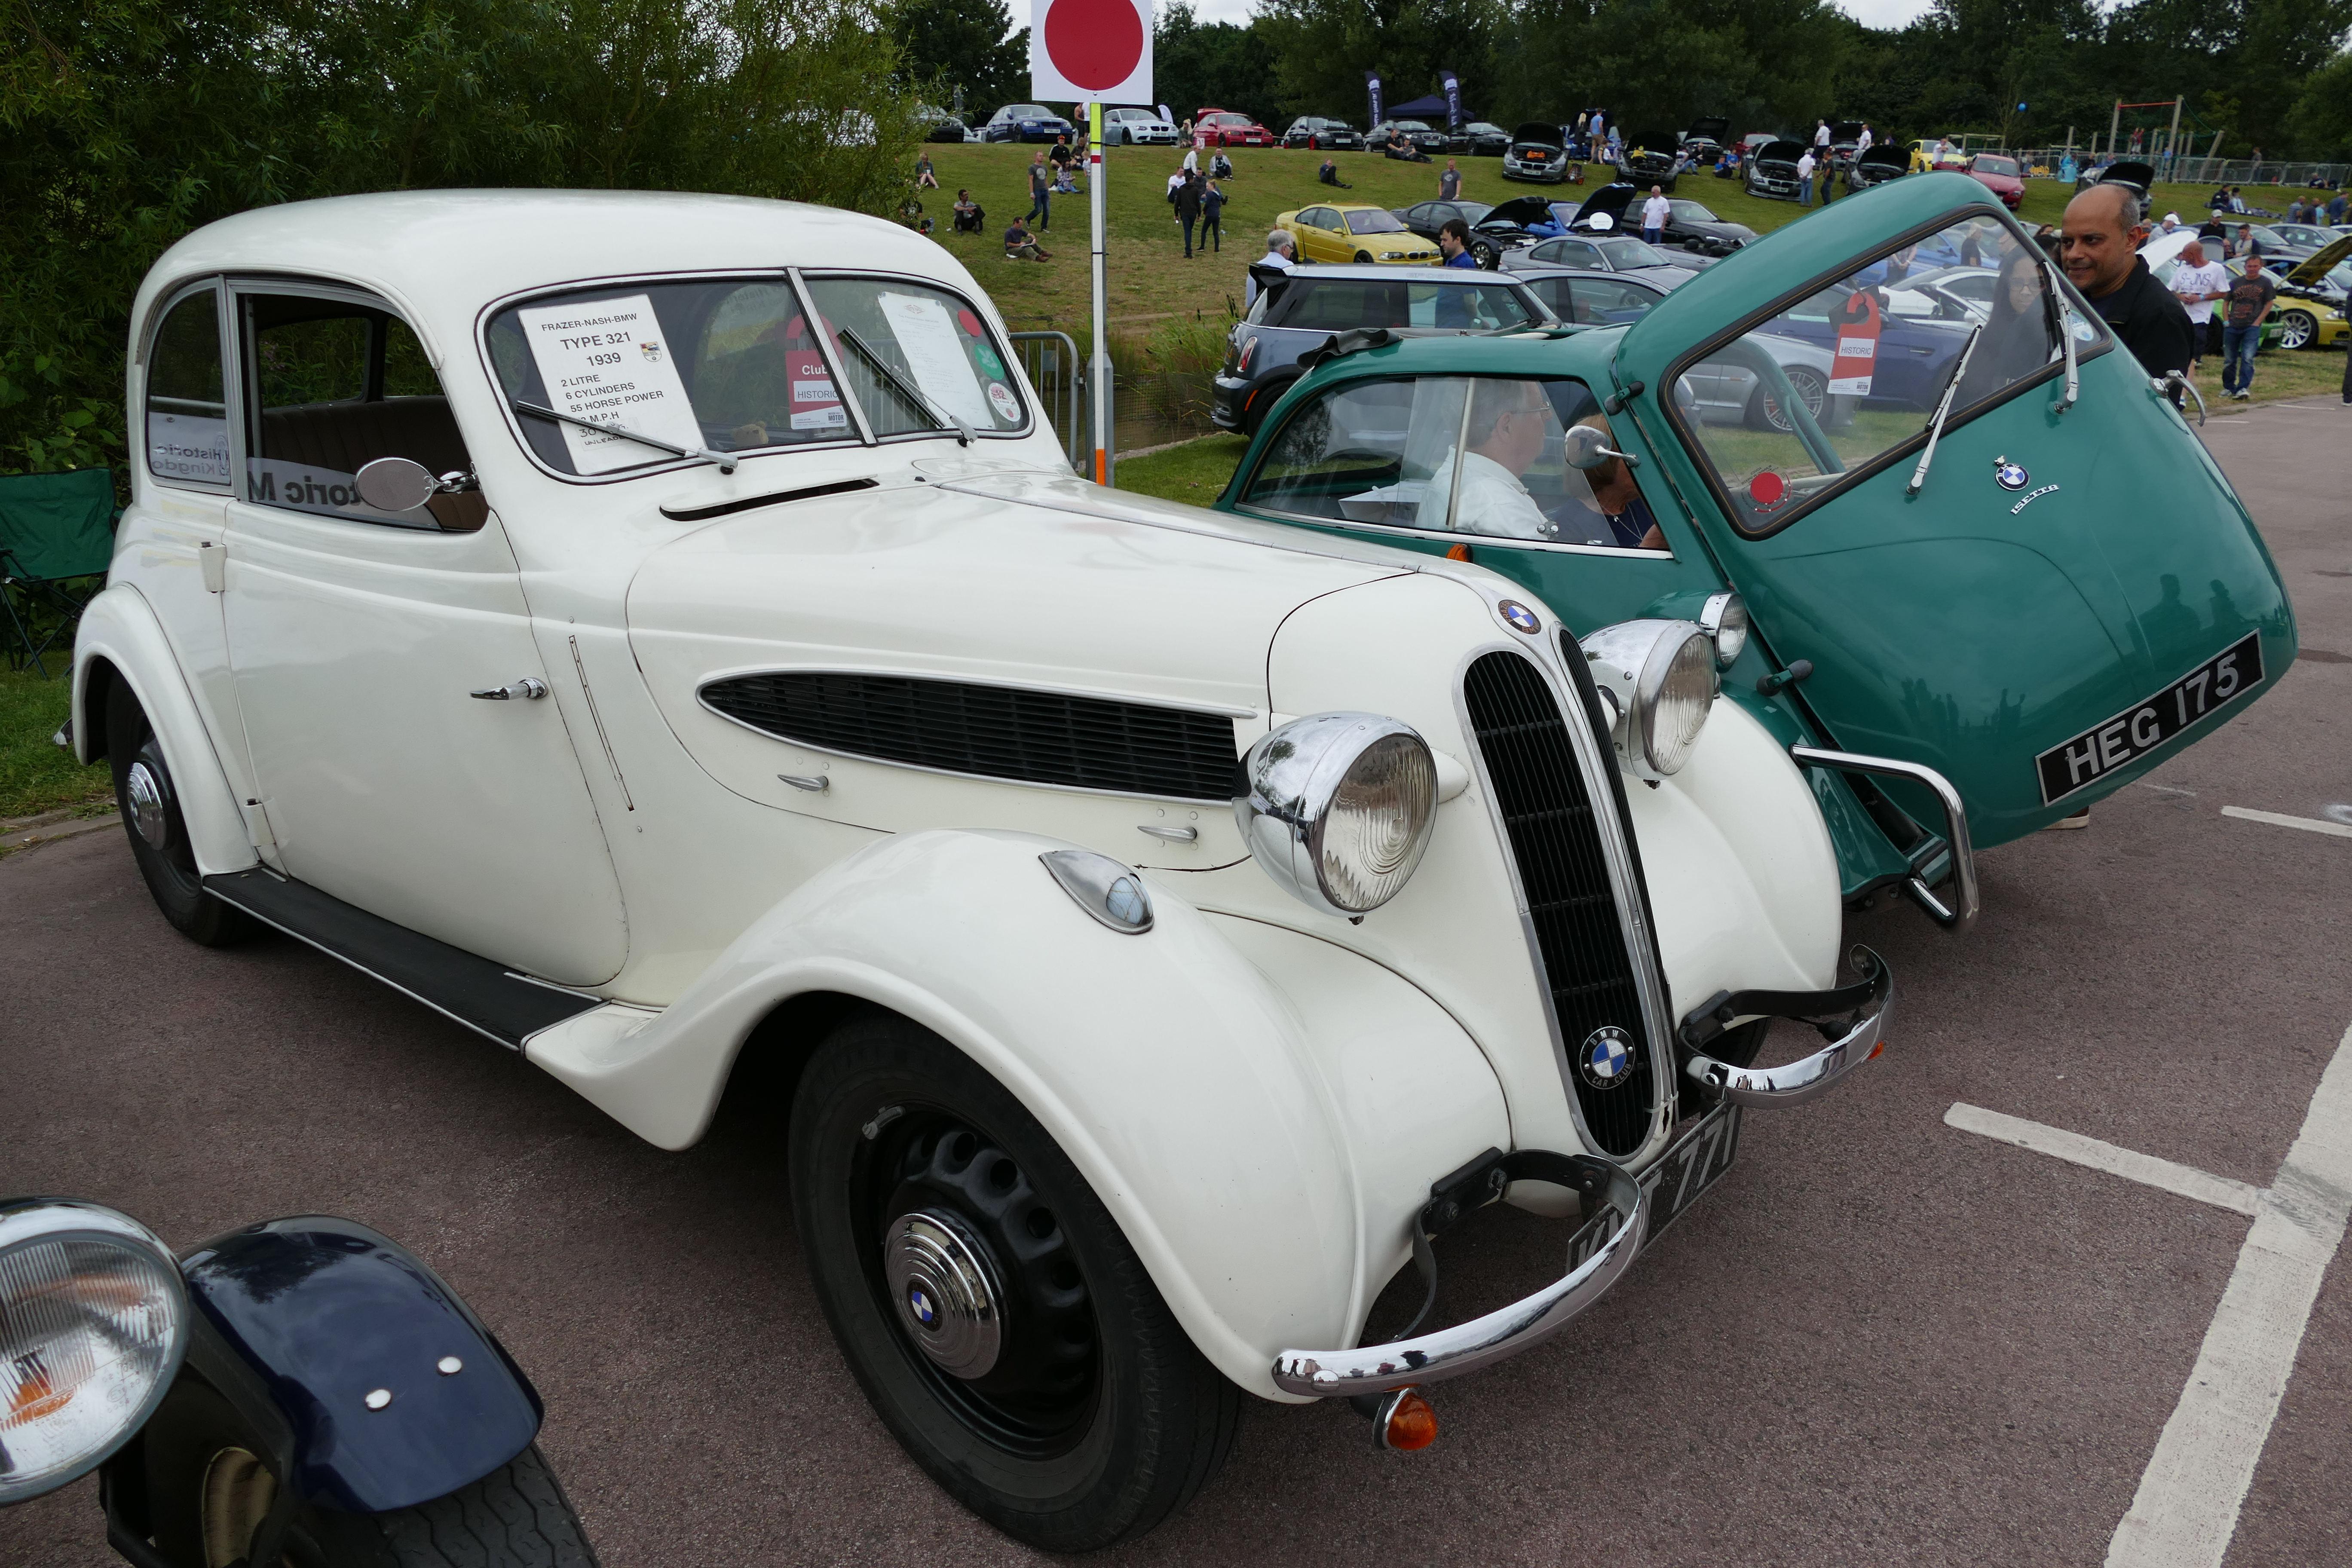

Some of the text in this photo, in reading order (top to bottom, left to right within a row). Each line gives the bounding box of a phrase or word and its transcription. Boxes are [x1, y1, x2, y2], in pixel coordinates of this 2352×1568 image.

[541, 313, 637, 332] FRAZER-NASH-BMW
[560, 331, 631, 350] TYPE 321
[586, 352, 622, 367] 1939
[1841, 346, 1871, 355] HISTORIC
[569, 374, 601, 386] LITRE
[566, 382, 636, 400] 6 CYLINDERS
[570, 390, 664, 413] 55 HORSE POWER
[1998, 464, 2019, 477] BMW
[2010, 484, 2060, 515] ISETTA
[1522, 624, 1540, 634] BMW
[2066, 652, 2239, 785] HEG 175
[1589, 1029, 1619, 1046] BMW
[1592, 1063, 1632, 1087] CAR CLUB
[1671, 1105, 1736, 1215] 771
